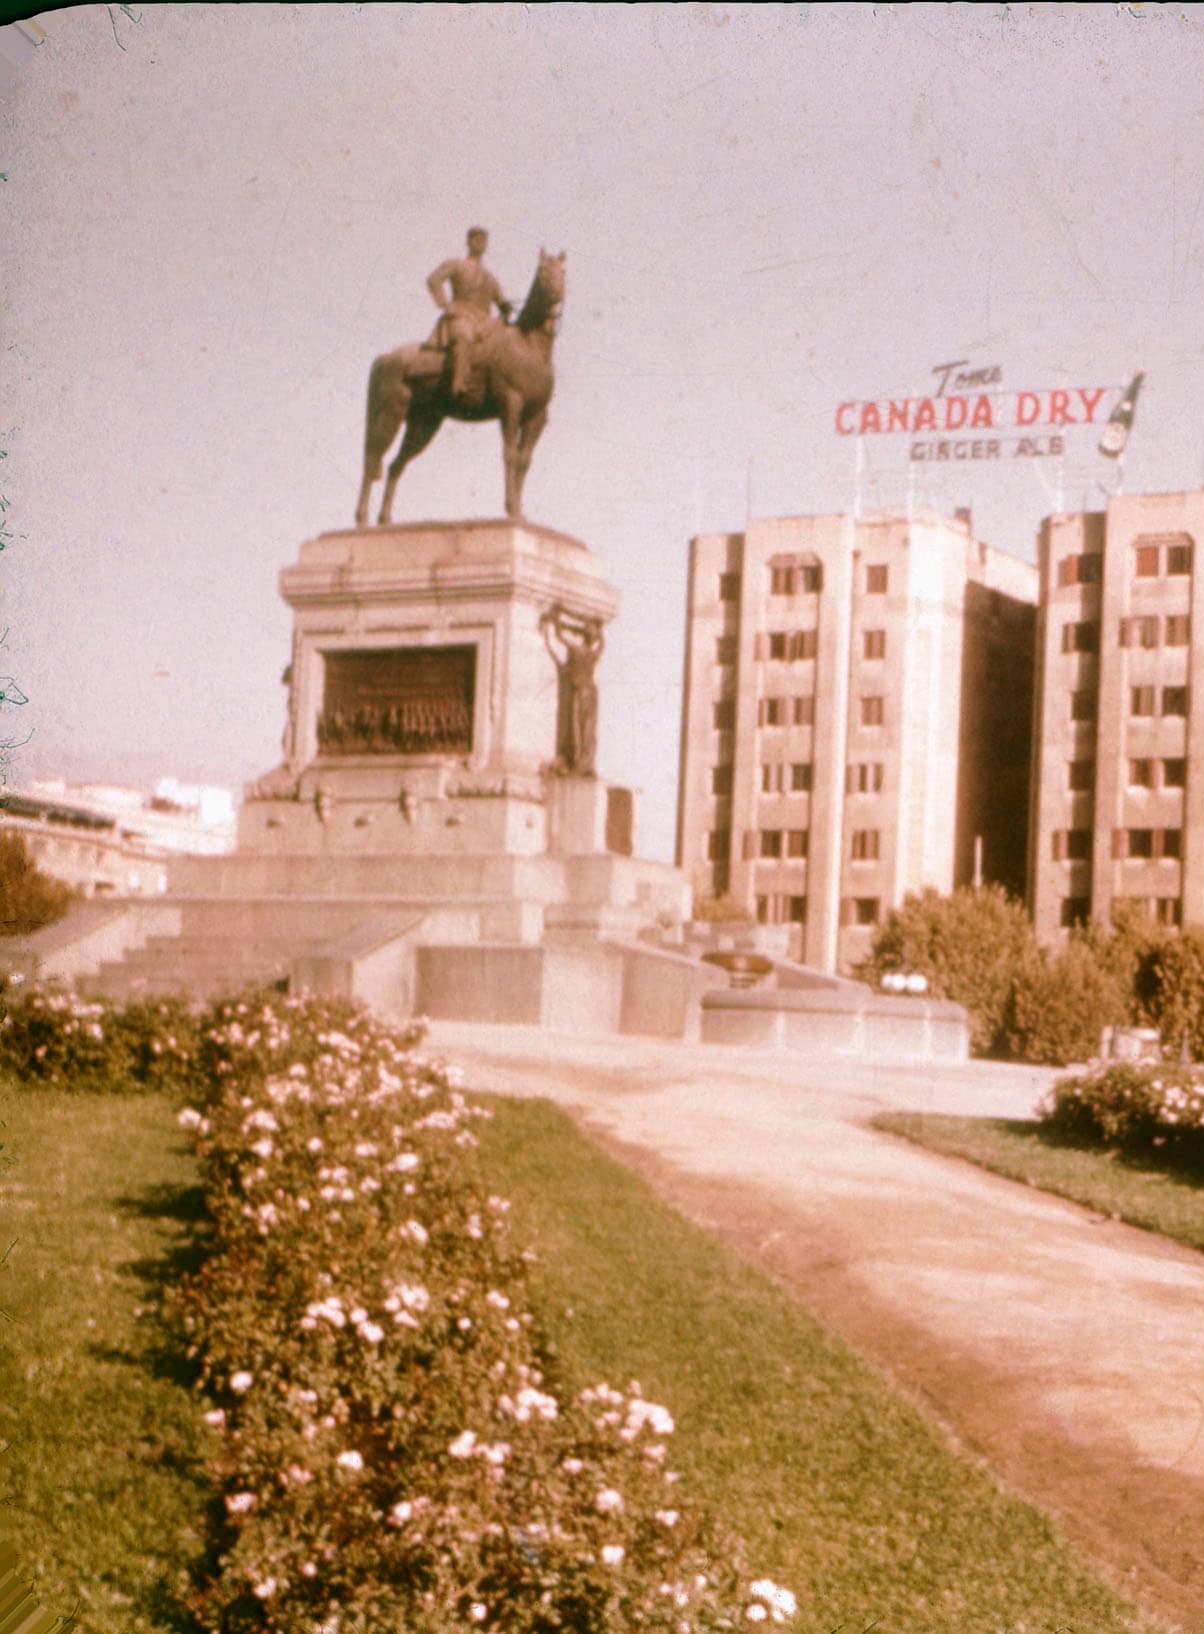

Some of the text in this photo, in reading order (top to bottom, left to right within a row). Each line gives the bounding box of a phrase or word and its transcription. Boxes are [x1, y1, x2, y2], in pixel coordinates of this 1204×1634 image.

[835, 388, 1105, 435] CANADA DRY
[910, 436, 1065, 461] GINGER ALE
